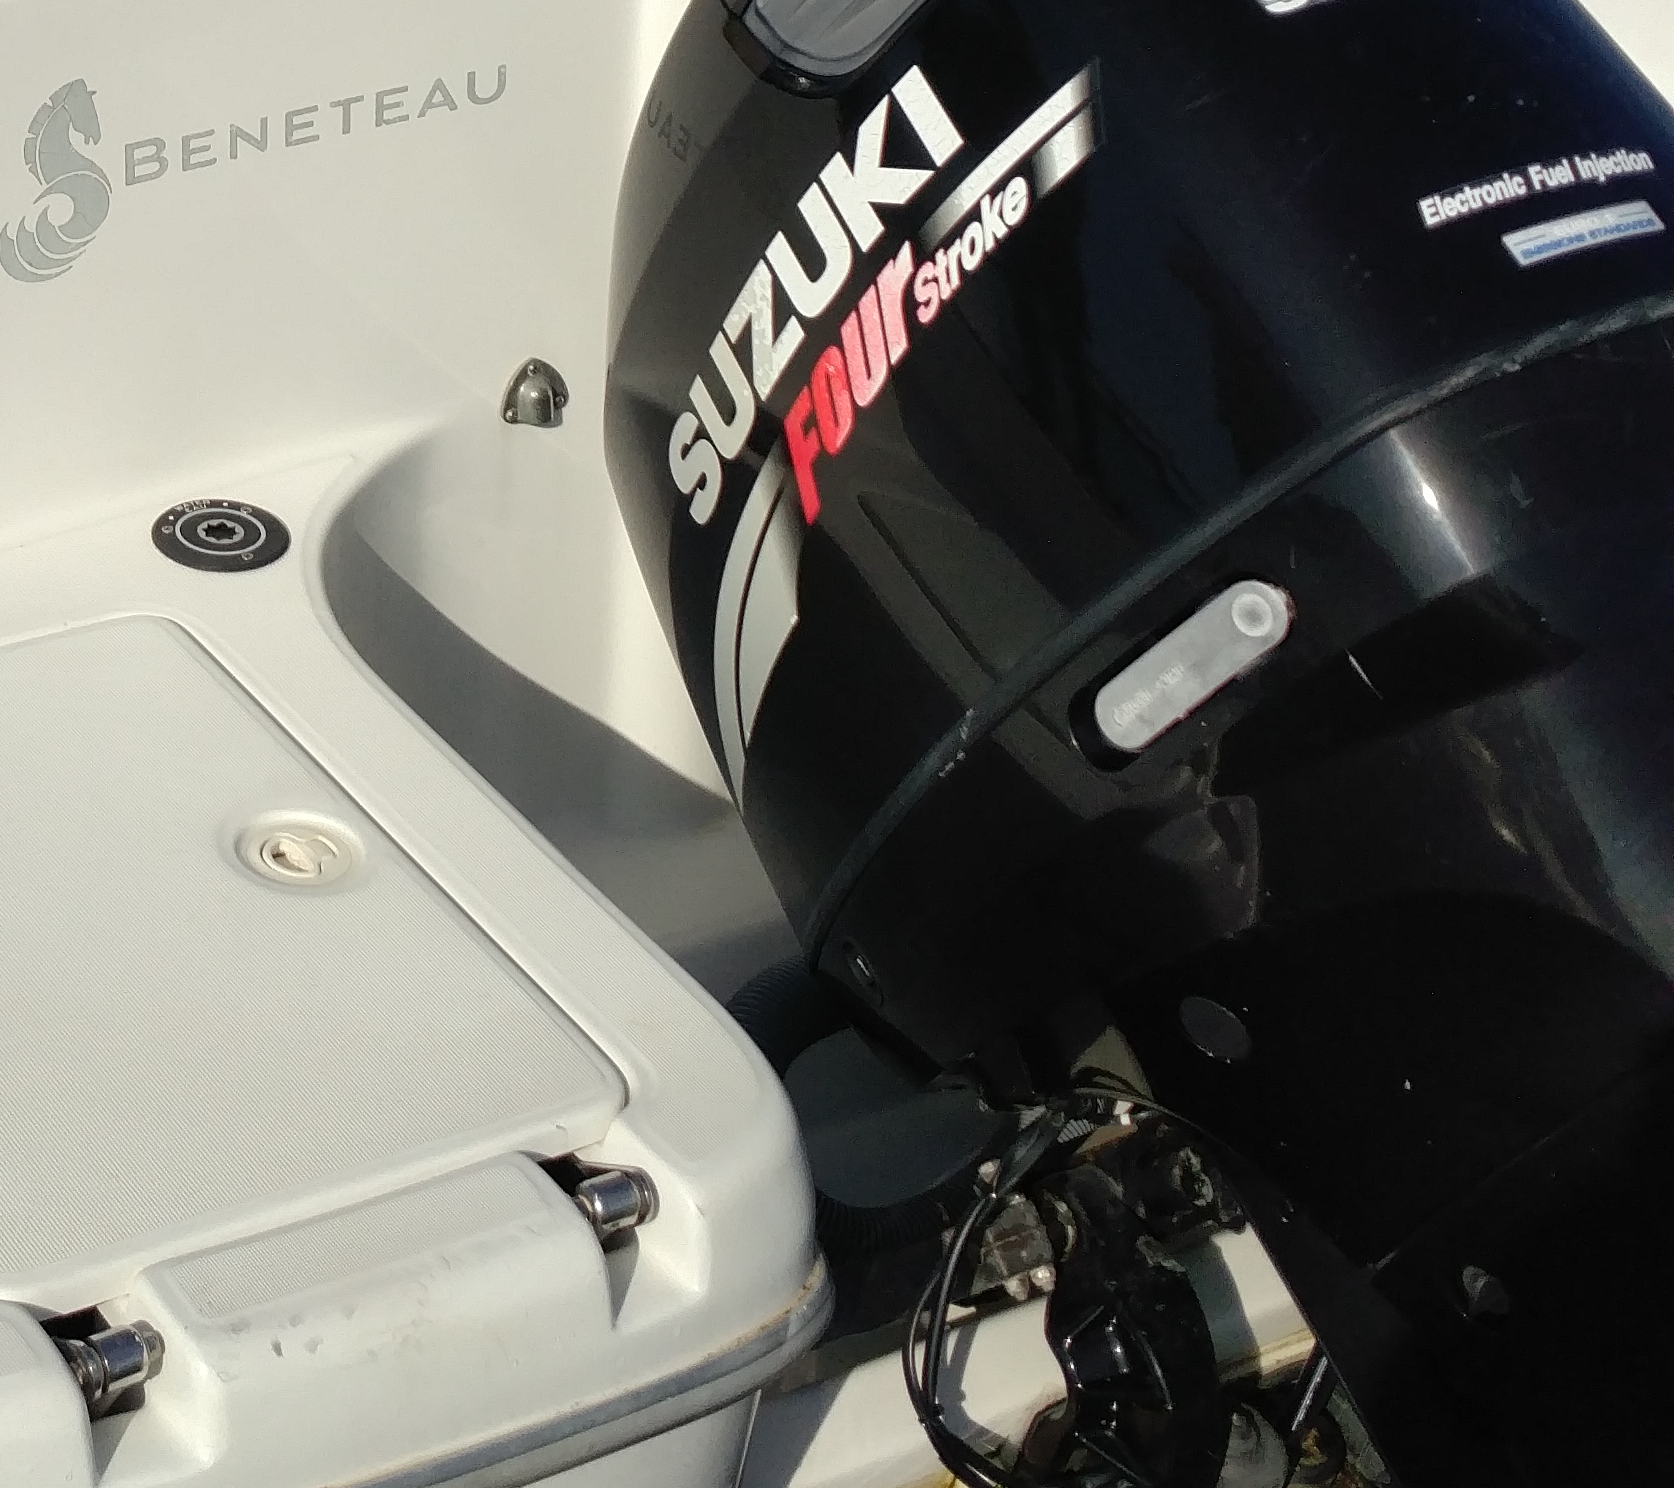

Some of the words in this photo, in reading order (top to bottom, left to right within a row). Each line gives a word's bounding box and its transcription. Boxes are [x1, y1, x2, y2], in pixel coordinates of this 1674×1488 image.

[125, 64, 507, 186] BENETEAU
[1418, 173, 1527, 226] Electronic
[1528, 158, 1575, 190] Fuel
[1574, 148, 1656, 184] Injection
[668, 64, 965, 525] SUZUKI
